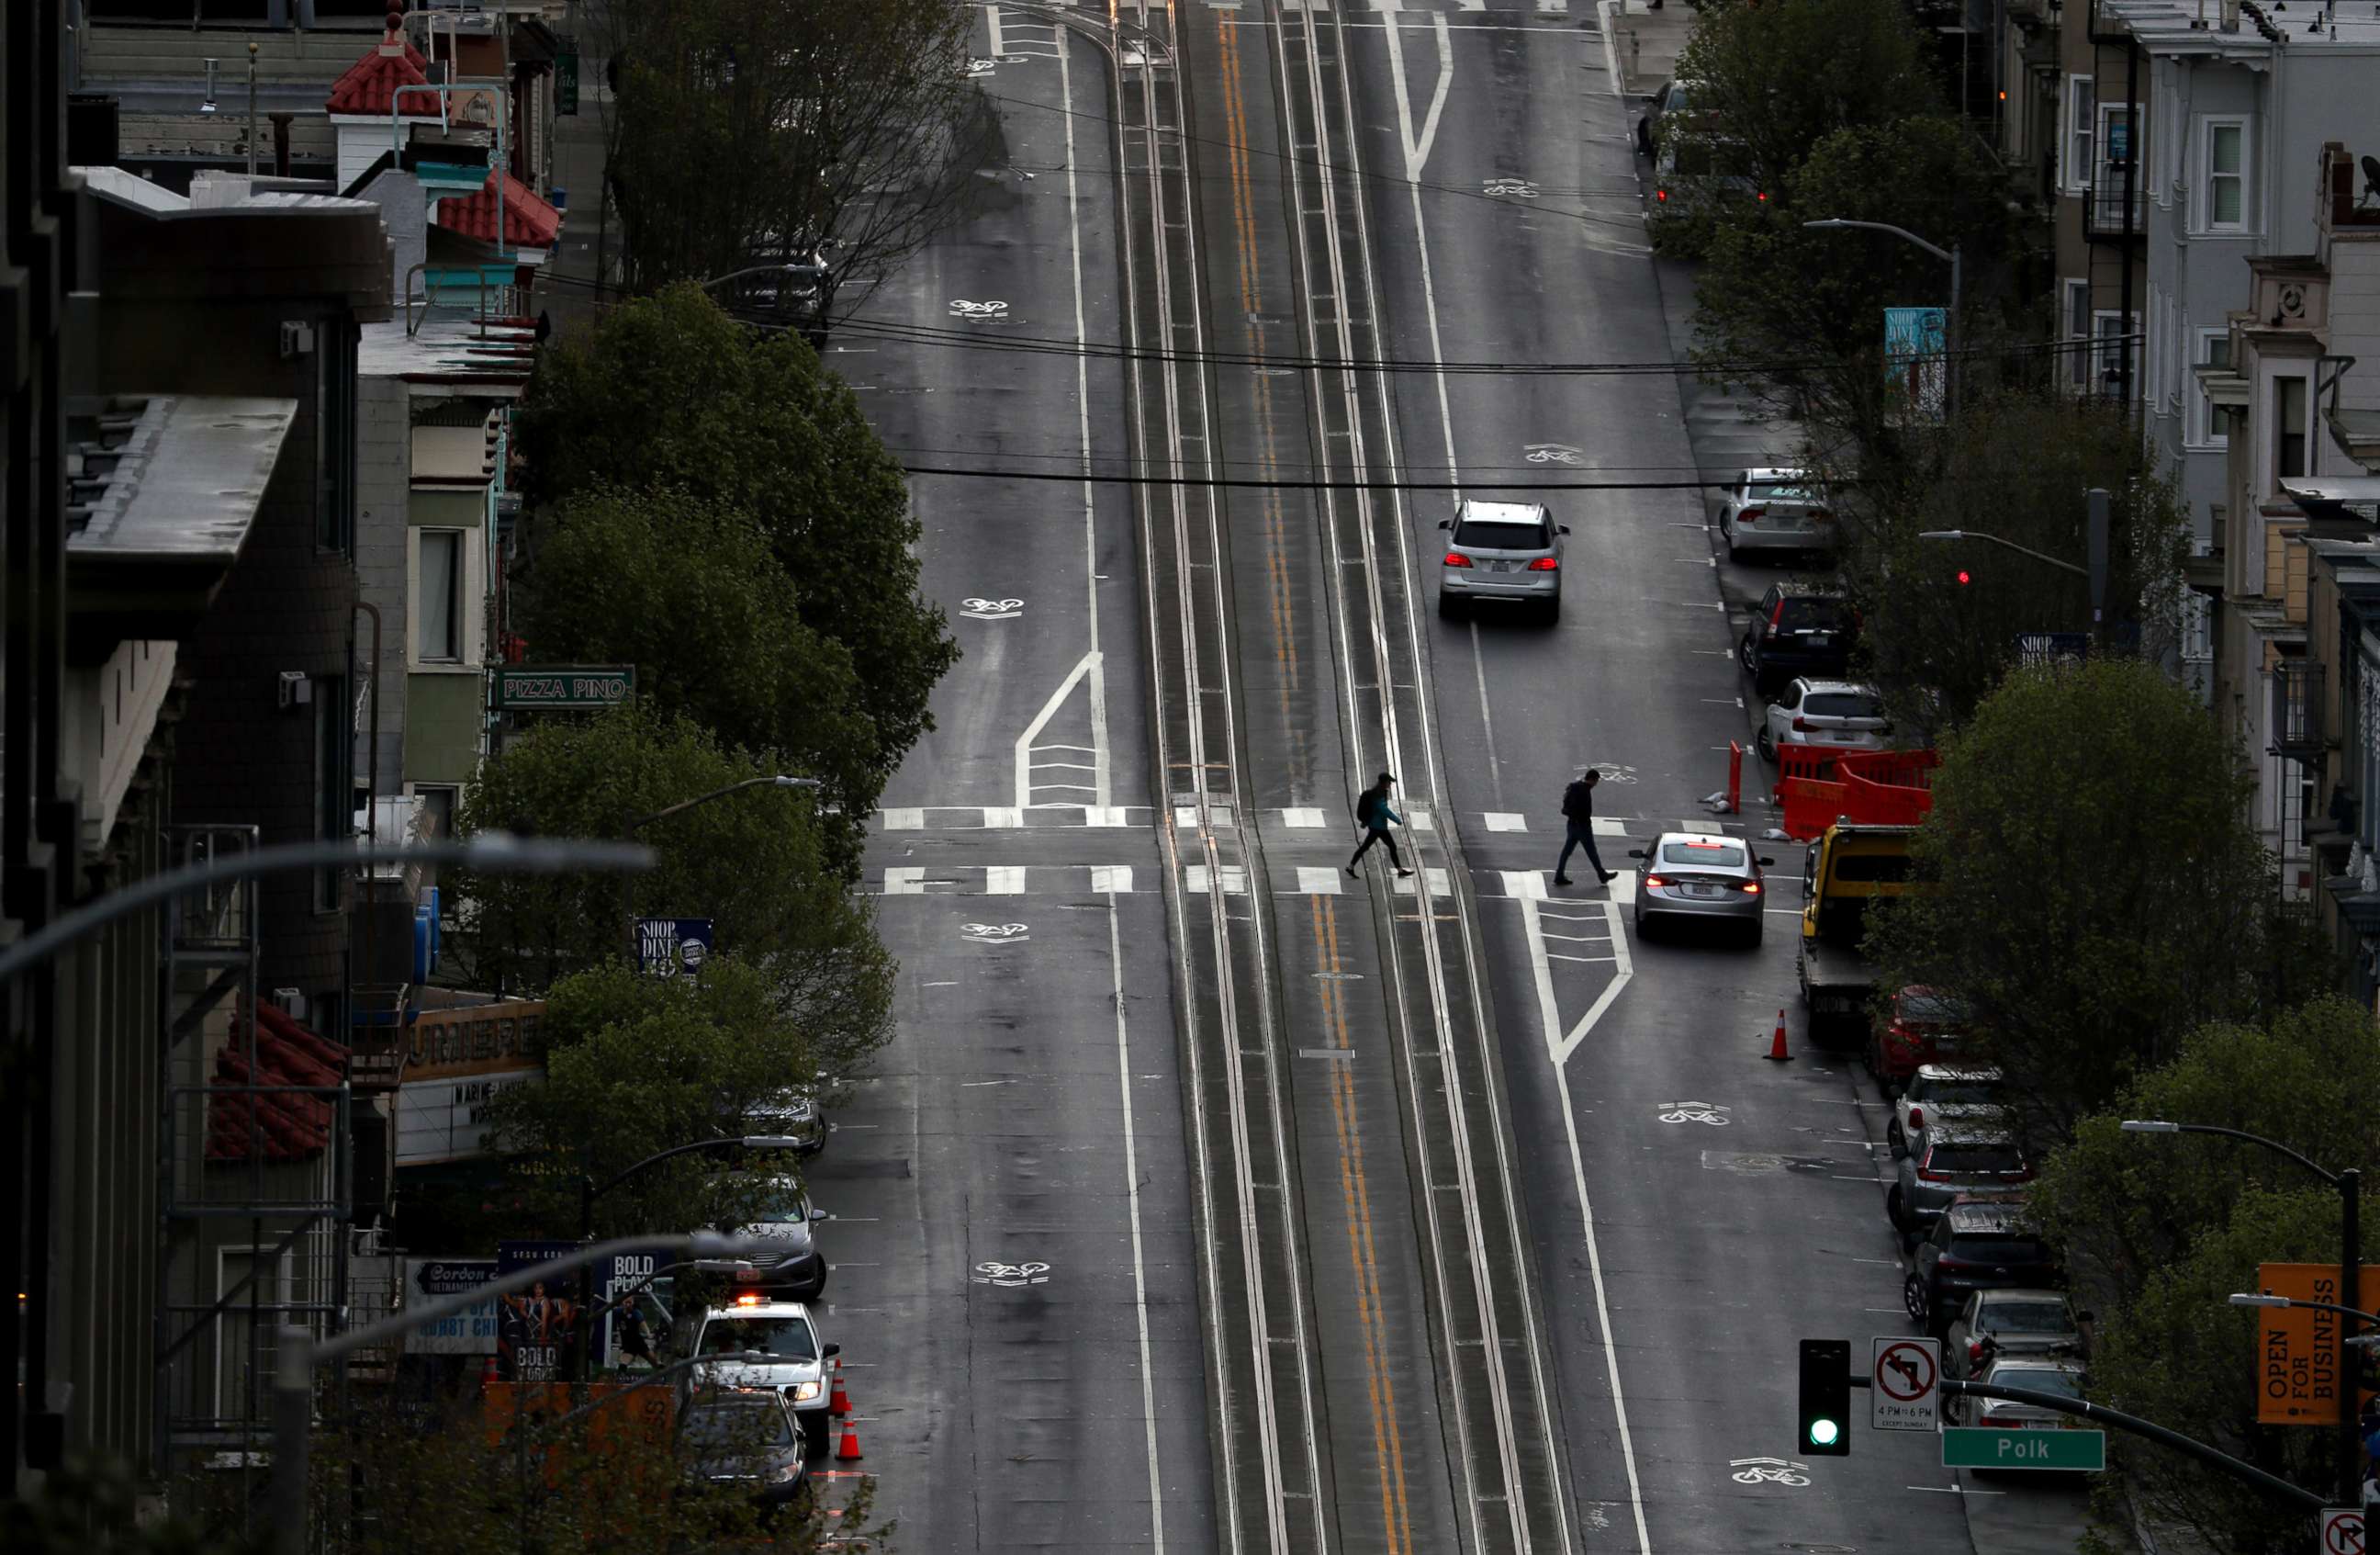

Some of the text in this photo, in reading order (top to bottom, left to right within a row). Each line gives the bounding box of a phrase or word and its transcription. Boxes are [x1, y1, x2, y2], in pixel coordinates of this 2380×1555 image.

[2021, 636, 2053, 652] SHOP
[503, 679, 626, 700] PIZZA PINO
[643, 920, 677, 938] SHOP
[614, 1256, 654, 1275] BOLD
[2314, 1279, 2334, 1399] BUSINESS
[518, 1347, 556, 1366] BOLD
[2268, 1330, 2287, 1399] OPEN
[2292, 1356, 2308, 1400] FOR
[1879, 1405, 1884, 1414] 4
[1888, 1406, 1901, 1416] PM
[1910, 1407, 1915, 1417] 6
[1919, 1407, 1932, 1417] PM
[1997, 1438, 2049, 1459] Polk
